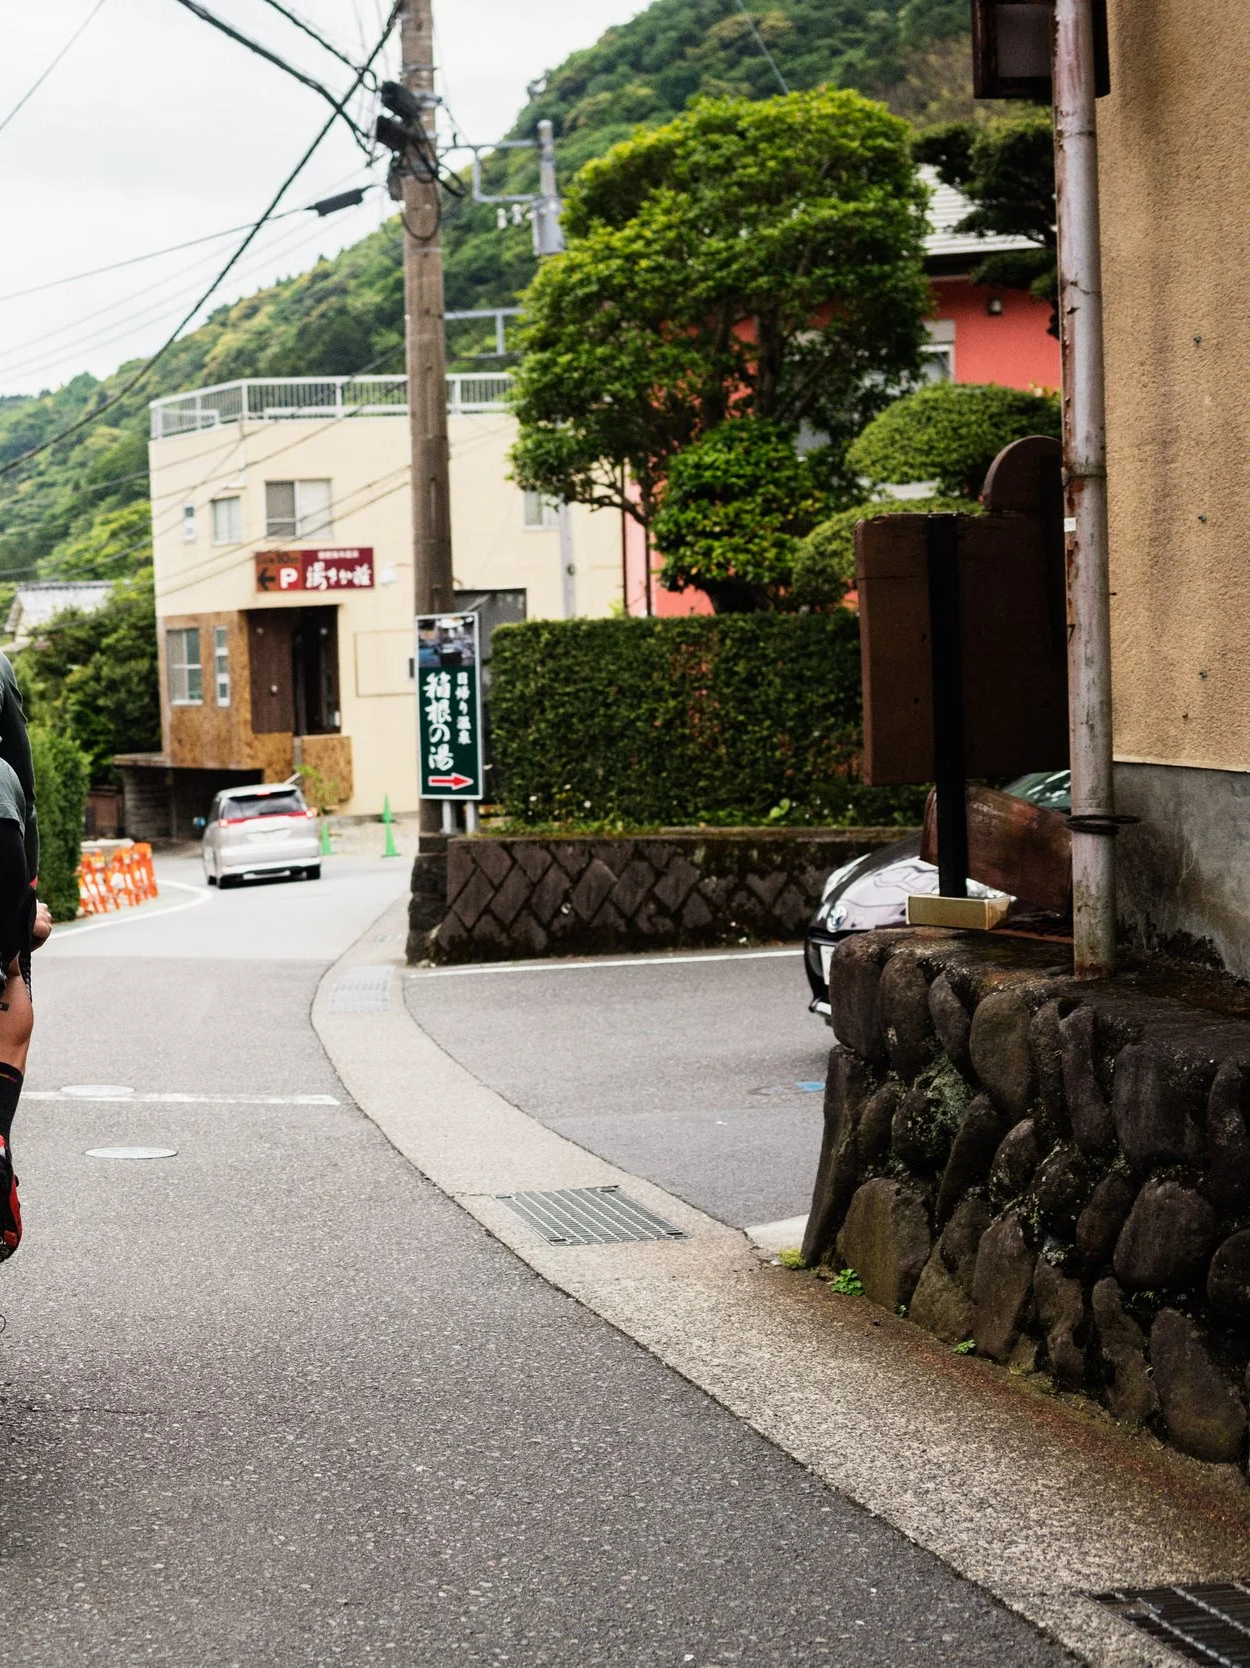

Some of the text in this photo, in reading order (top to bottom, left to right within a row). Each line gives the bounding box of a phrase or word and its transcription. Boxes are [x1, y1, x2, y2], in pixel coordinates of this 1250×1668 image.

[279, 567, 299, 590] P
[422, 671, 454, 771] 箱根の湯
[454, 671, 472, 745] 日帰り温泉
